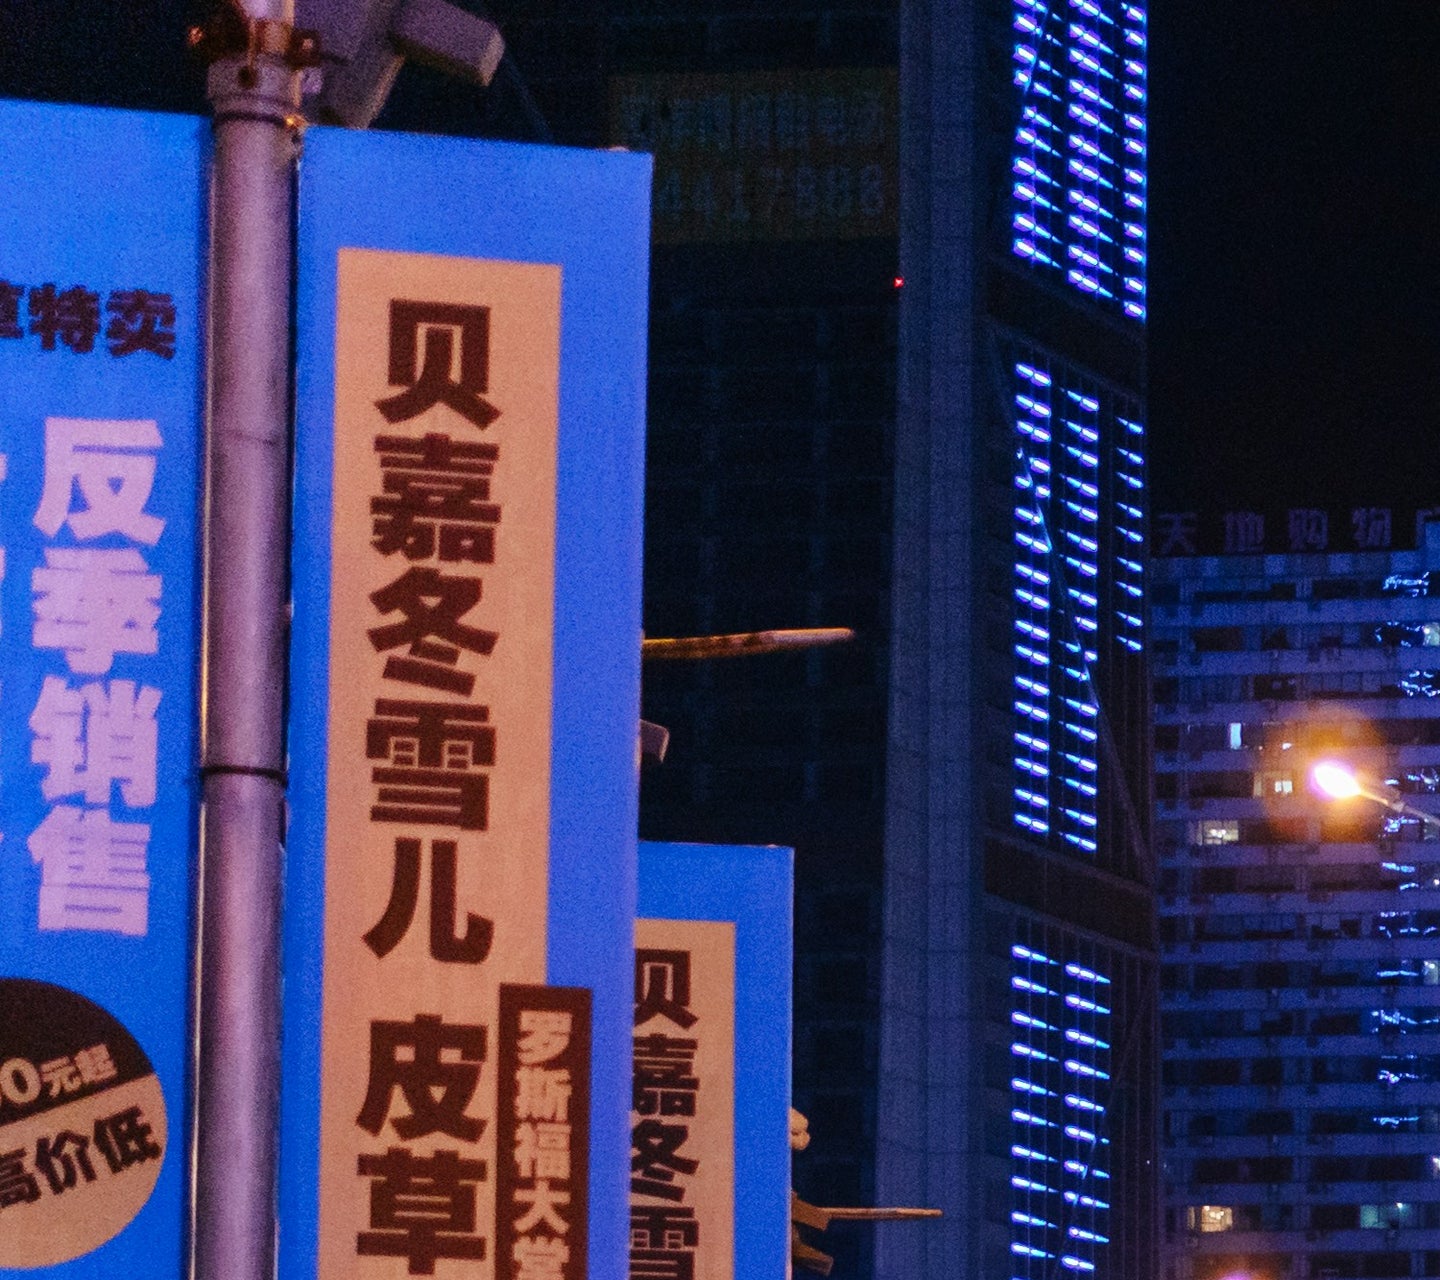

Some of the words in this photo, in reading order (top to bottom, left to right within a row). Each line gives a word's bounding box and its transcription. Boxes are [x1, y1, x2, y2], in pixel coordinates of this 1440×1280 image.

[27, 417, 166, 936] 反季销售
[357, 299, 502, 1277] 贝嘉冬雪儿皮草
